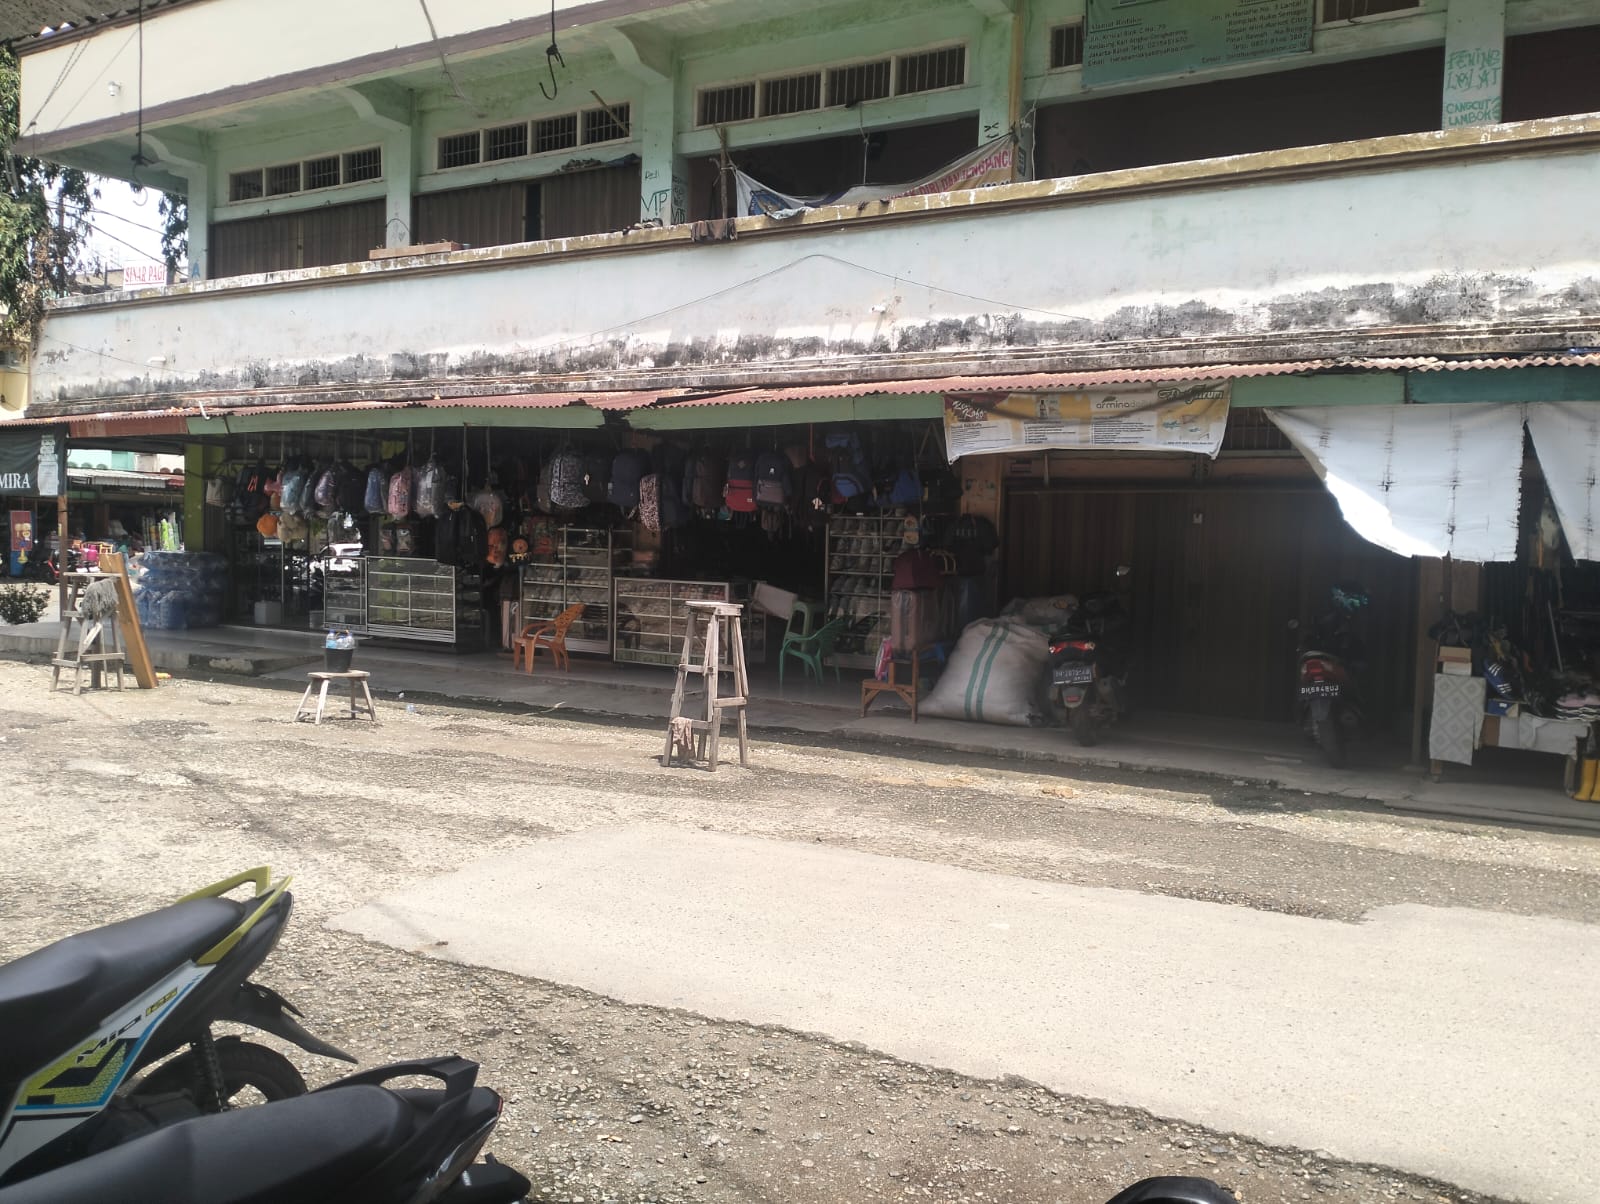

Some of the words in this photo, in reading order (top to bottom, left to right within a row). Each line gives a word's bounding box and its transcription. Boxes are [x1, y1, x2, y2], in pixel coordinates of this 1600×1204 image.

[125, 265, 147, 282] SINAR
[148, 264, 165, 281] PAGI
[0, 472, 31, 489] MIRA
